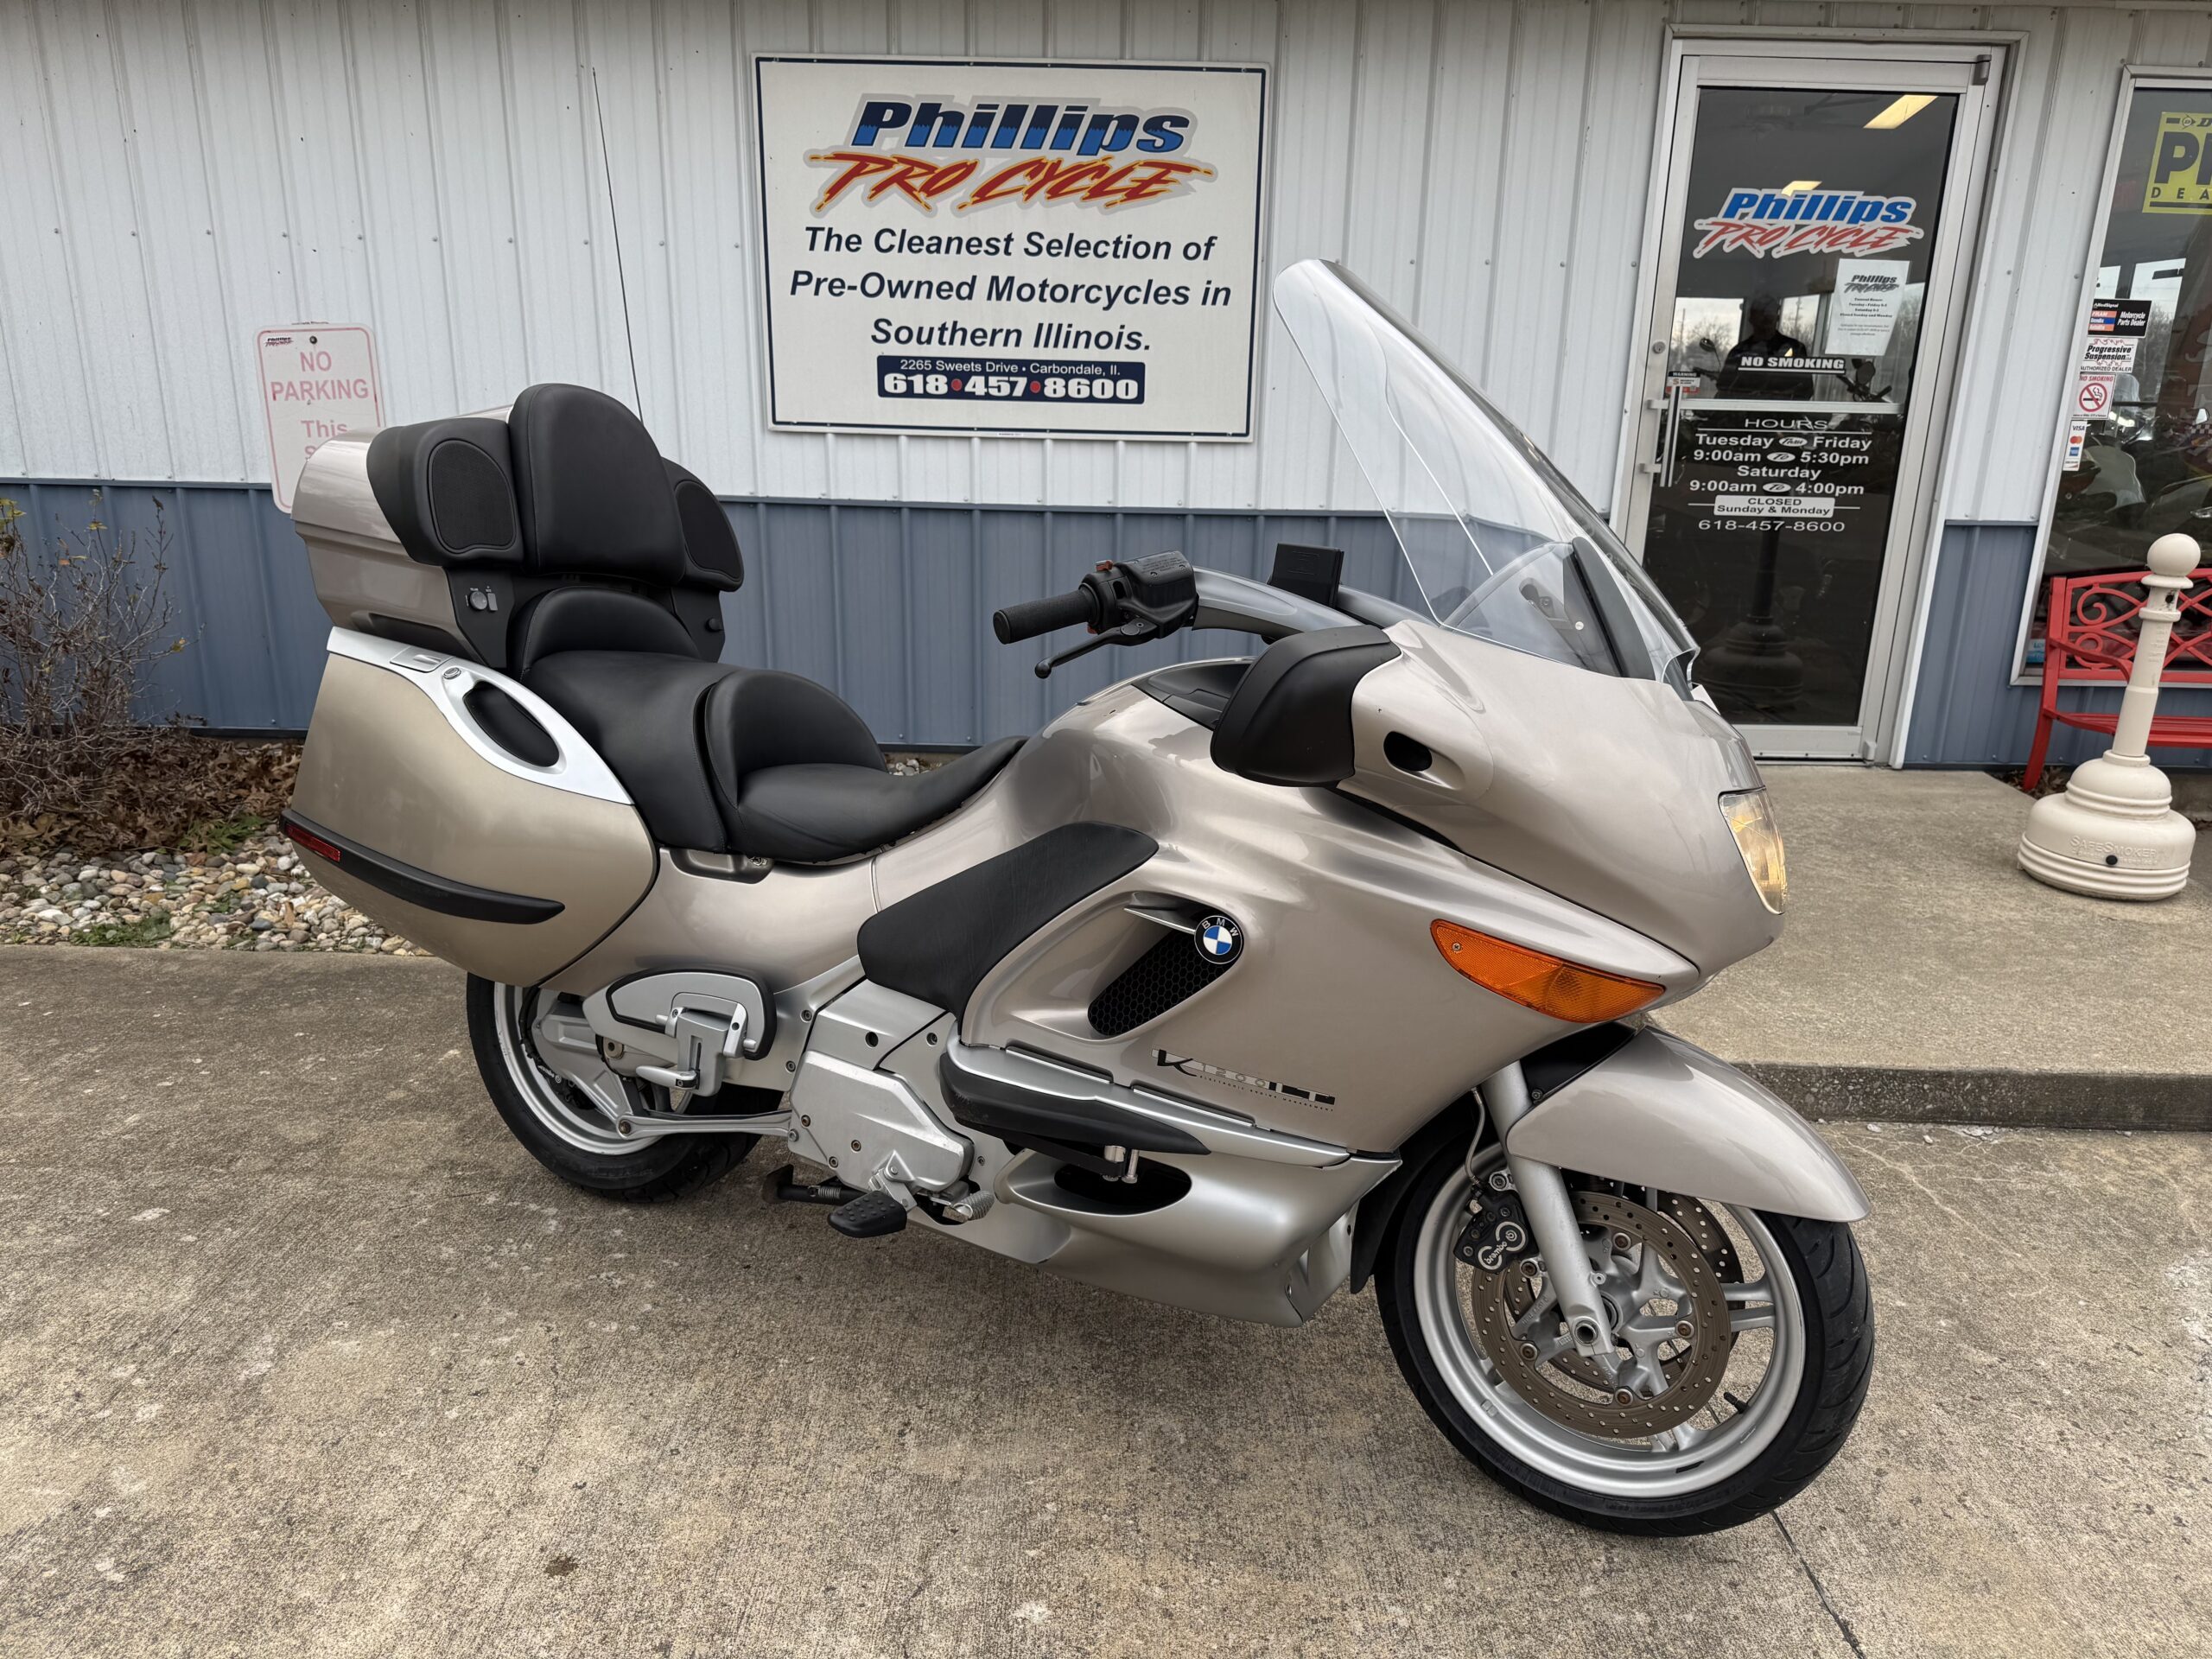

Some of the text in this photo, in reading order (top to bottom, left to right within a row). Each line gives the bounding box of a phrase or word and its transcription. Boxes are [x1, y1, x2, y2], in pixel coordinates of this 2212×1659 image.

[850, 100, 1191, 156] Phillips
[810, 151, 1213, 212] PRO CYCLE
[1721, 193, 1912, 225] Phillips
[804, 226, 1217, 261] The Cleanest Selection of
[1697, 221, 1920, 256] PRO CYCLE
[790, 270, 1231, 310] Pre-Owned Motorcycles in
[871, 318, 1151, 351] Southern Illinois.
[300, 351, 332, 372] NO
[1741, 356, 1845, 369] NO SMOKING
[2085, 353, 2126, 361] Suspension
[900, 359, 931, 370] 2265
[936, 360, 982, 372] Sweets
[986, 363, 1018, 373] Drive
[1030, 363, 1106, 377] Carbondale,
[270, 379, 368, 401] PARKING
[301, 420, 347, 437] This
[1745, 418, 1828, 429] HOURS
[1695, 434, 1774, 448] Tuesday
[1813, 436, 1872, 451] Friday
[1694, 449, 1761, 461] 9:00am
[1800, 451, 1869, 466] 5:30pm
[1737, 465, 1821, 480] Saturday
[1689, 480, 1757, 493] 9:00am
[1796, 482, 1865, 496] 4:00pm
[1717, 505, 1764, 515] Sunday
[1781, 506, 1830, 517] Monday
[1698, 520, 1846, 532] 618-457-8600
[1202, 918, 1239, 937] BMW
[1484, 1241, 1508, 1264] brembo
